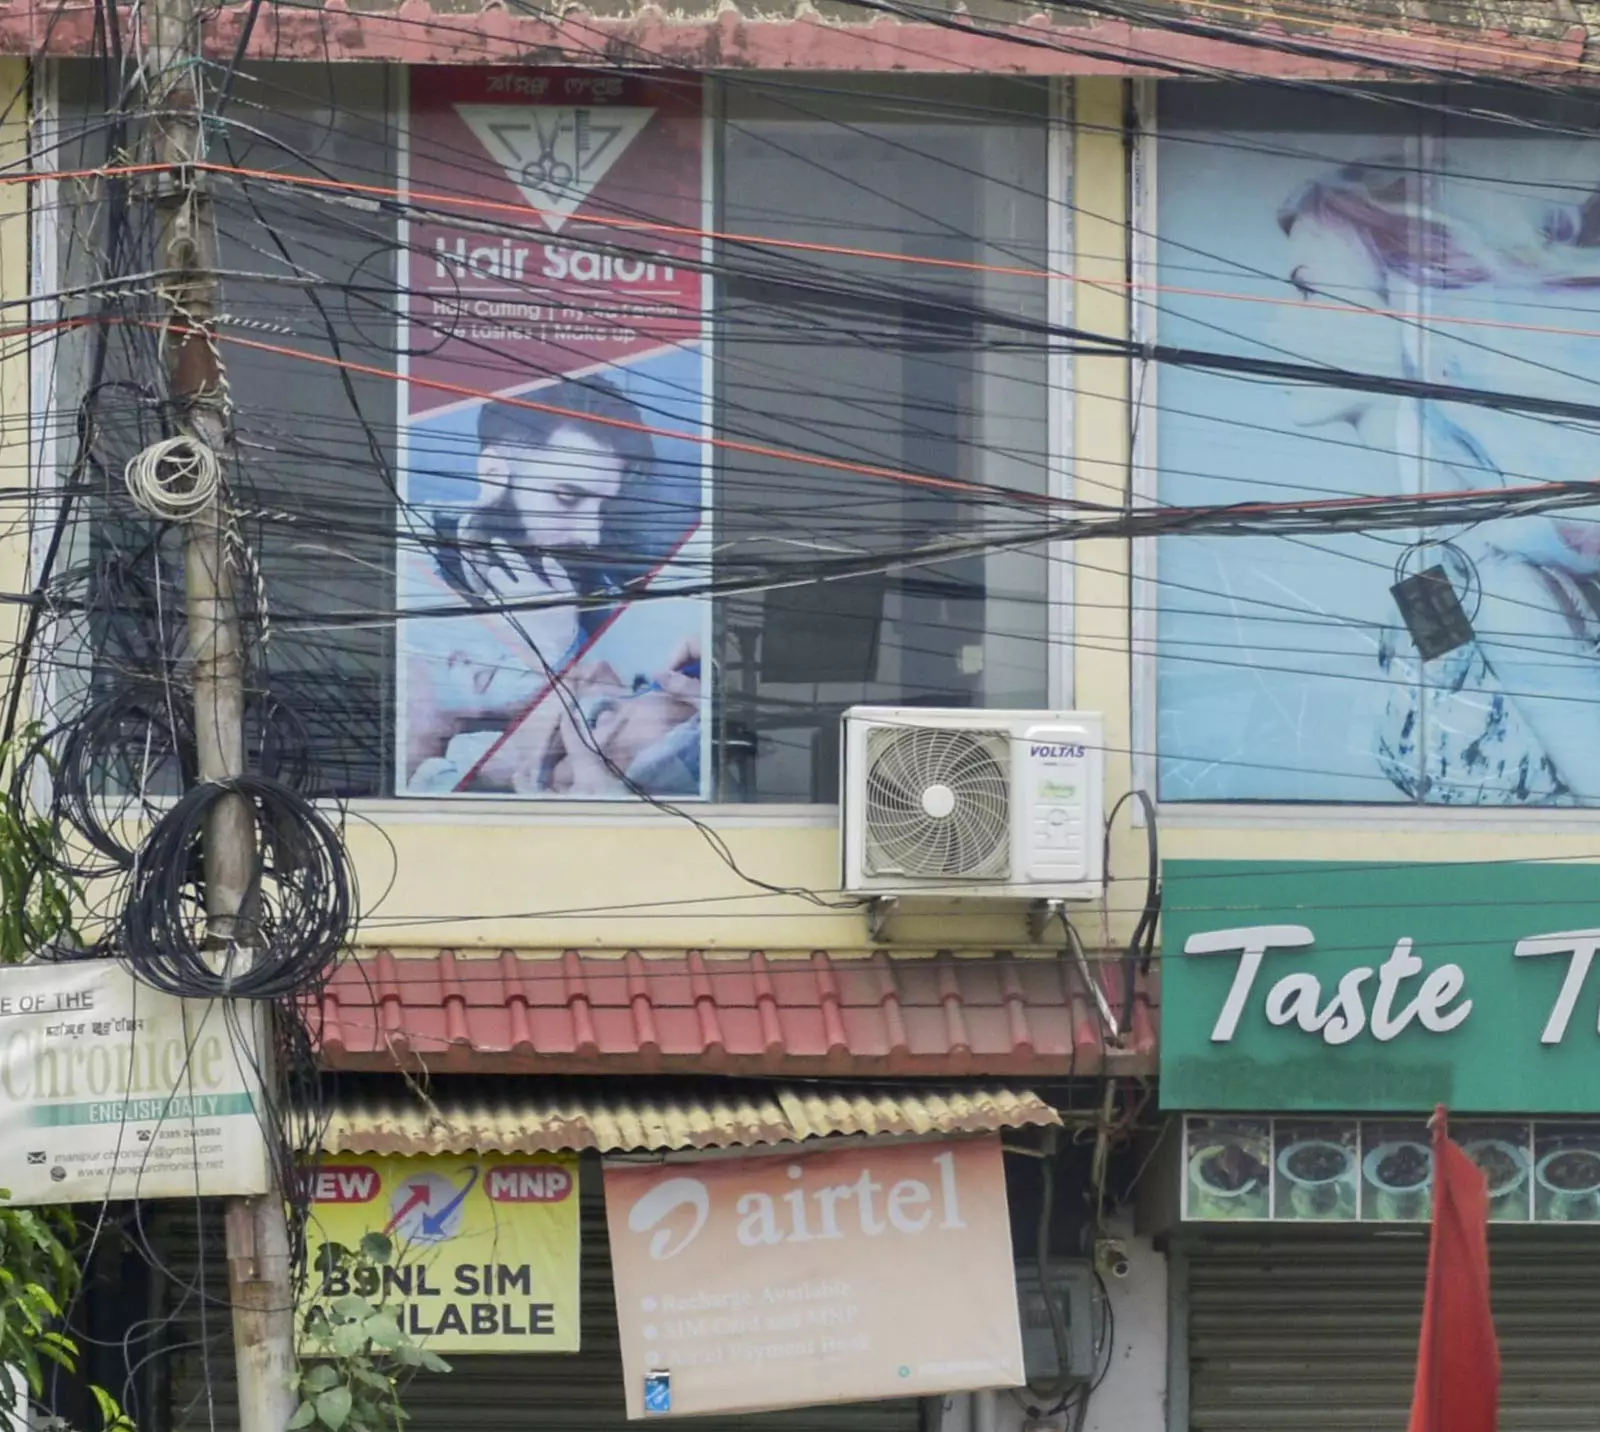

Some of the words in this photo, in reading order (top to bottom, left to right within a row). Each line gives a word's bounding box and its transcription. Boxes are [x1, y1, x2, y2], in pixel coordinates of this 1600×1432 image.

[436, 237, 528, 280] Hair
[543, 240, 674, 282] Salon
[1030, 745, 1085, 759] VOLTAS
[1184, 923, 1473, 1046] Taste
[19, 994, 47, 1014] OF
[54, 990, 95, 1011] THE
[1, 1014, 224, 1101] Chronicle
[88, 1100, 163, 1122] ENGLISH
[169, 1096, 219, 1116] DAILY
[490, 1172, 568, 1199] MNP
[736, 1152, 968, 1248] airtel
[453, 1263, 532, 1297] SIM
